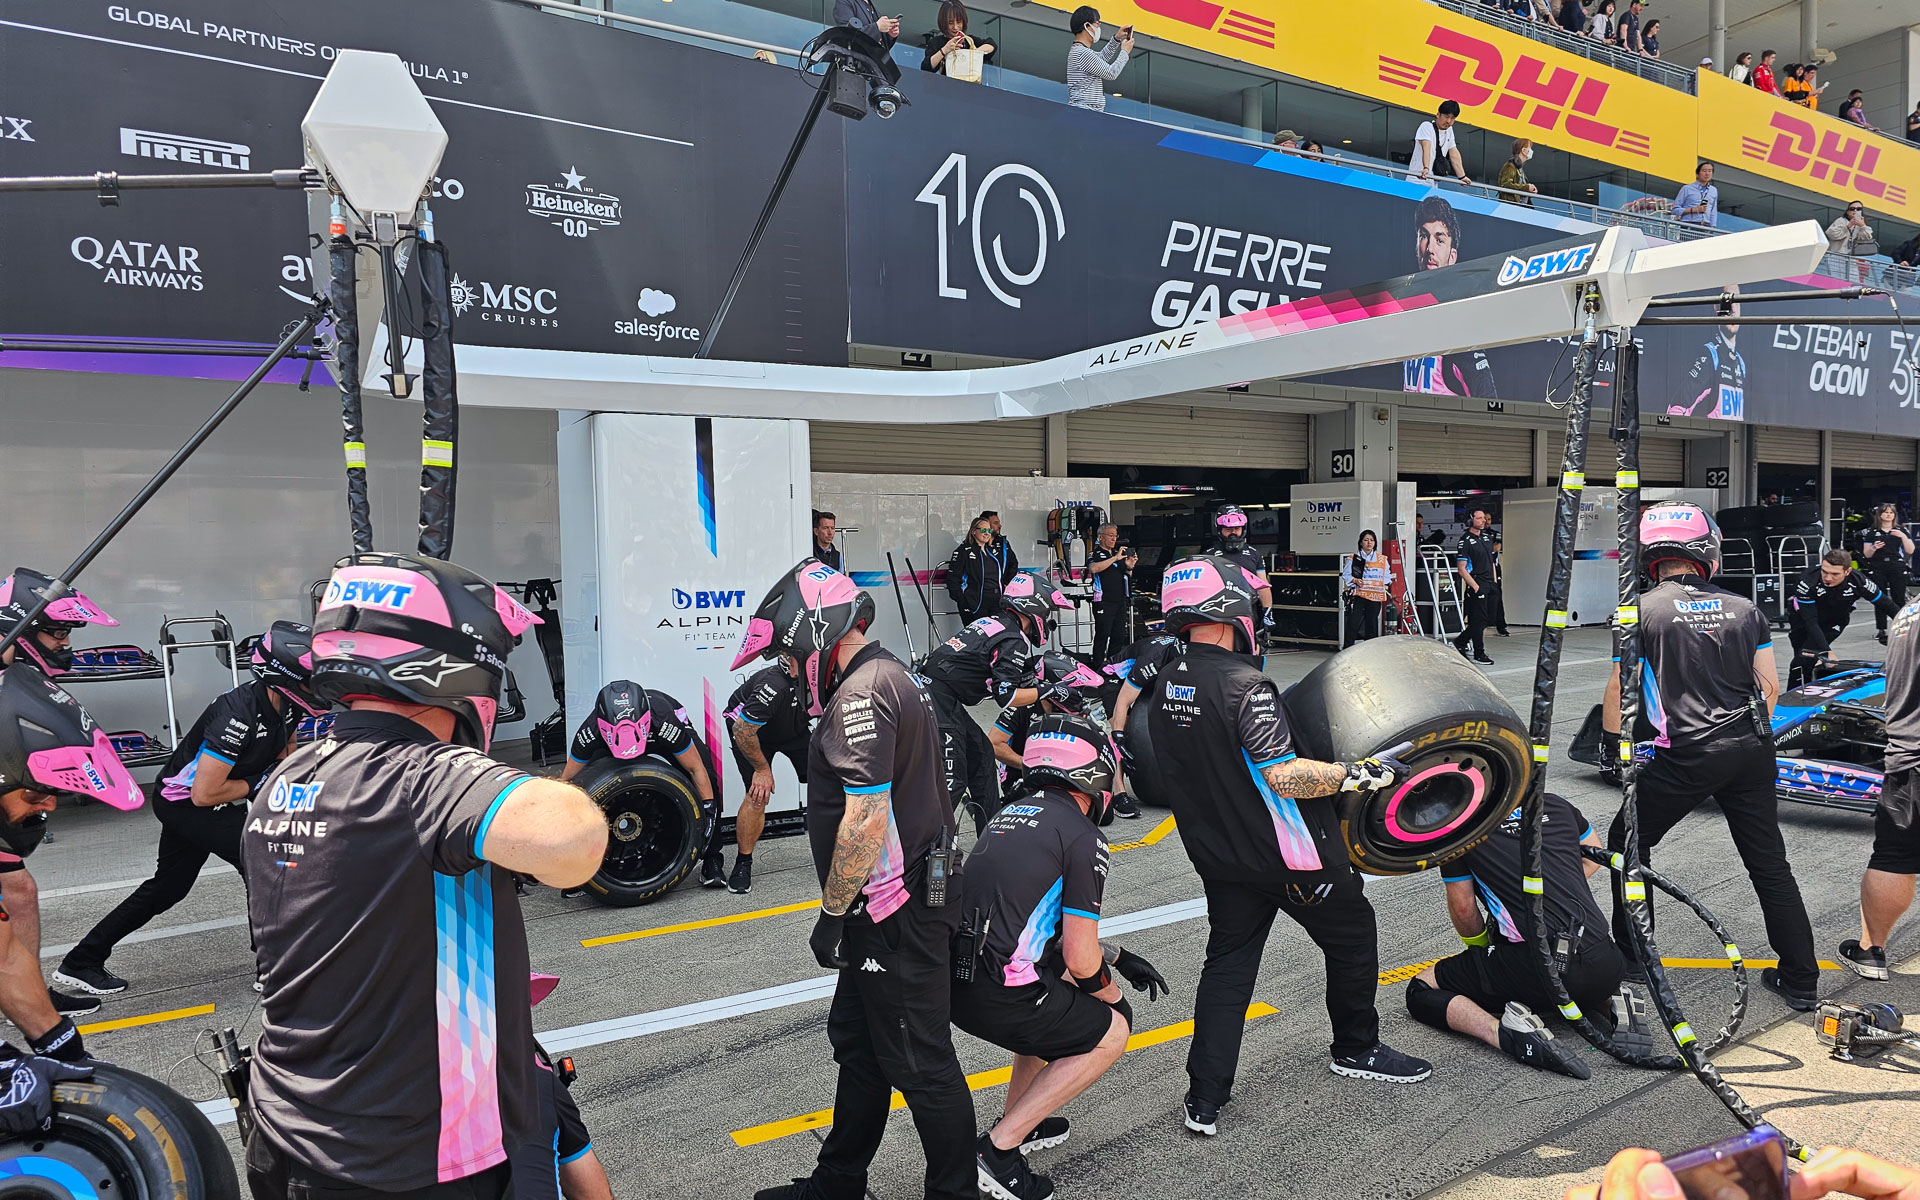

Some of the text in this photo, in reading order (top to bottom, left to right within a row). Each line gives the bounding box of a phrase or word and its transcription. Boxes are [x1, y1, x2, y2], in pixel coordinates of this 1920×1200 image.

[108, 5, 199, 35] GLOBAL
[204, 23, 316, 57] PARTNERS
[1422, 25, 1619, 147] DHL
[120, 127, 250, 170] PIRELLI
[1768, 112, 1889, 199] DHL
[563, 218, 587, 238] 0.0
[915, 152, 1065, 308] 10
[70, 236, 202, 273] QATAR
[1161, 220, 1332, 289] PIERRE
[1526, 247, 1592, 277] BWT
[103, 269, 204, 291] AIRWAYS
[480, 281, 558, 315] MSC
[481, 312, 559, 328] CRUISES
[614, 318, 700, 341] salesforce
[1090, 332, 1197, 368] ALPINE
[1773, 324, 1872, 361] ESTEBAN
[1809, 360, 1869, 397] OCON
[1333, 454, 1353, 474] 30
[1707, 471, 1728, 487] 32
[1318, 502, 1342, 512] BWT
[1301, 515, 1350, 523] ALPINE
[1171, 568, 1202, 583] BWT
[342, 581, 413, 609] BWT
[696, 591, 745, 608] BWT
[1690, 600, 1720, 611] BWT
[657, 615, 755, 628] ALPIN
[787, 607, 807, 639] shamir
[1672, 612, 1736, 622] ALPINE
[705, 632, 736, 640] TEAM
[1175, 686, 1194, 701] BWT
[850, 698, 871, 710] BWT
[1162, 703, 1201, 715] ALPINE
[944, 733, 953, 791] ALPIN
[88, 768, 106, 791] BWT
[1013, 805, 1041, 815] BWT
[248, 818, 327, 837] ALPINE
[988, 817, 1039, 828] ALPINE
[282, 843, 304, 855] TEAM
